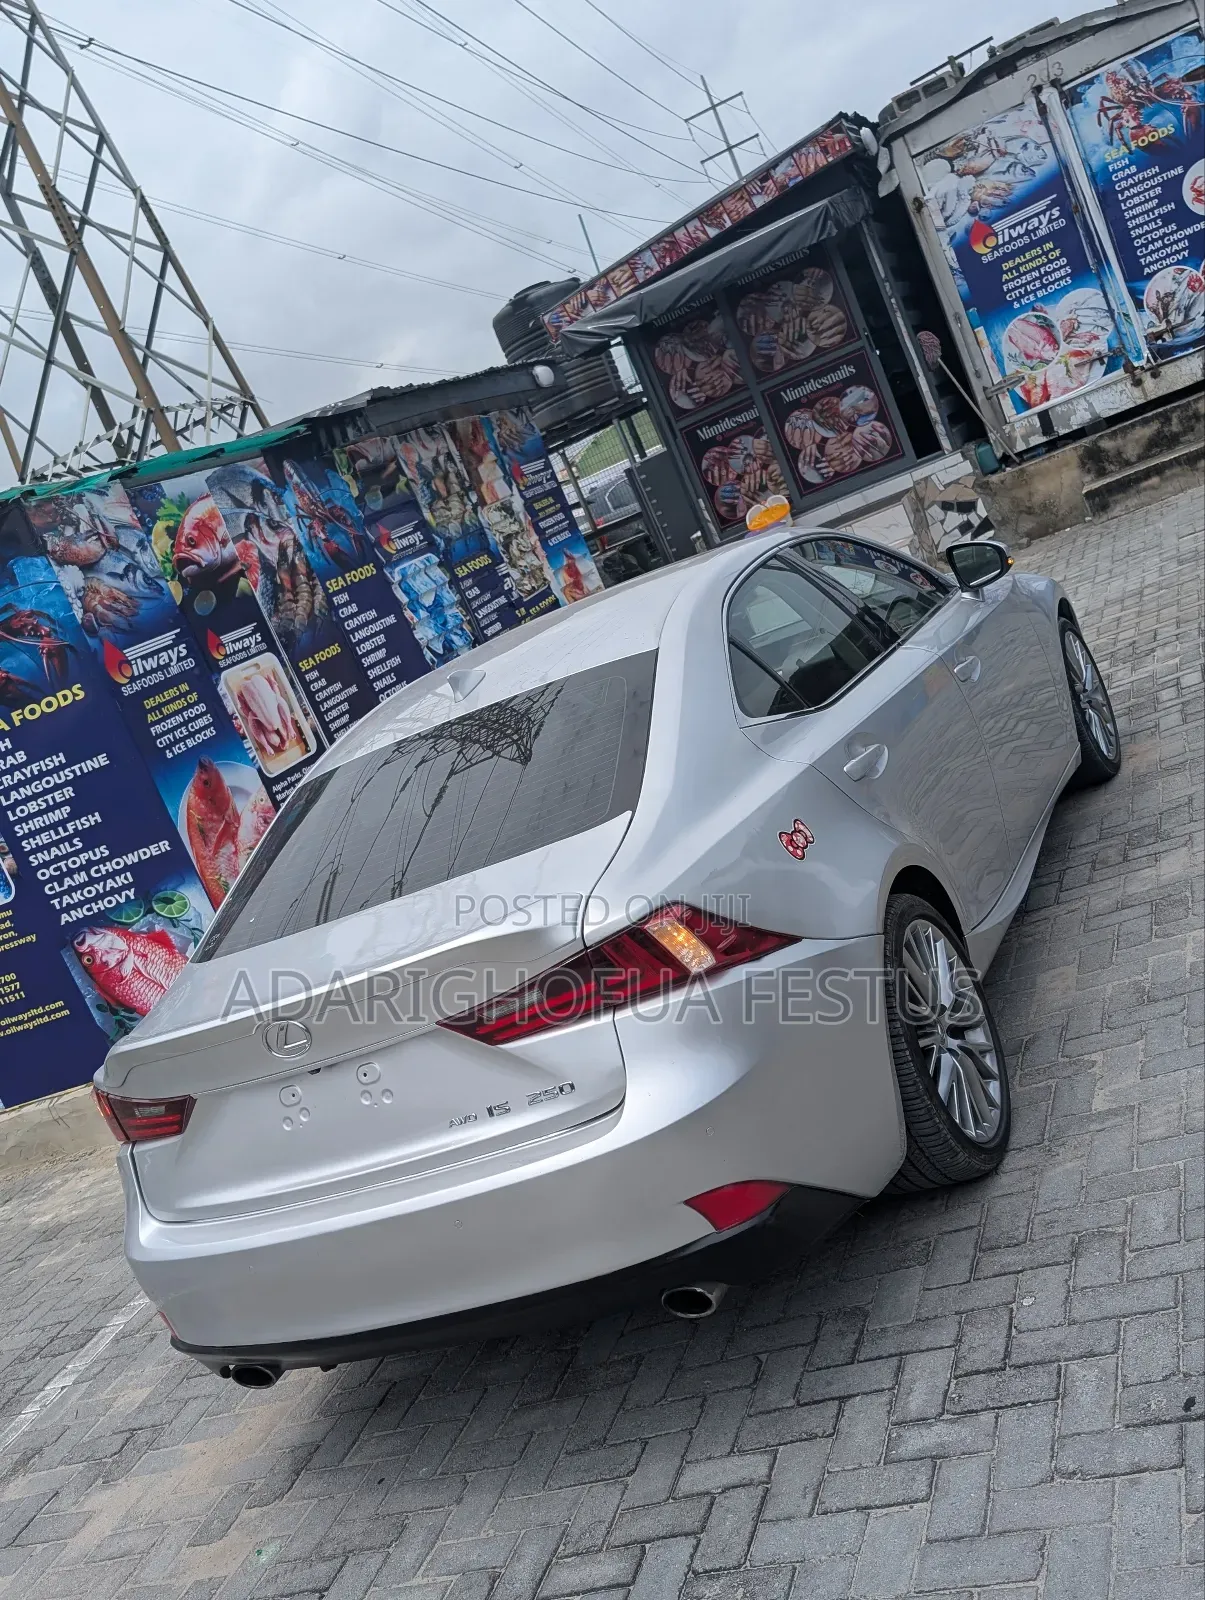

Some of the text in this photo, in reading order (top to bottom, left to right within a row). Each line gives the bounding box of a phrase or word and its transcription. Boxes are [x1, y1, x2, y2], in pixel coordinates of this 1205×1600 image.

[1104, 124, 1176, 162] SEA FOODS
[1108, 158, 1130, 172] FISH
[1112, 165, 1138, 182] CRAB
[1114, 166, 1160, 191] CRAYFISH
[1118, 166, 1184, 200] LANGOUSTINE
[1121, 186, 1162, 210] LOBSTER
[1124, 199, 1159, 220] SHRIMP
[983, 206, 1060, 249] Oilways
[1127, 202, 1176, 228] SHELLFISH
[1130, 219, 1162, 238] SNAILS
[982, 218, 1066, 264] SEAFOODS LIMITED
[1134, 222, 1177, 247] OCTOPUS
[1136, 220, 1205, 256] CLAM CHOWDE
[1002, 242, 1054, 270] DEALERS IN
[1002, 248, 1062, 282] ALL KINDS OF
[1139, 239, 1188, 266] TAKOYAKI
[1144, 250, 1189, 276] ANCHOVY
[1002, 258, 1067, 292] FROZEN FOOD
[1006, 266, 1072, 300] CITY ICE CUBES
[1021, 294, 1036, 304] ICE
[1036, 276, 1072, 298] BLOCKS
[780, 364, 856, 404] Mimidesnails
[697, 405, 760, 442] Mimidesnai
[326, 563, 376, 593] SEA FOODS
[333, 592, 349, 606] FISH
[466, 587, 480, 599] CRAB
[339, 603, 358, 618] CRAB
[344, 609, 377, 630] CRAYFISH
[475, 596, 508, 619] LANGOUSTINE
[350, 614, 397, 642] LANGOUSTINE
[299, 643, 342, 672] SEA FOODS
[356, 634, 386, 655] LOBSTER
[362, 648, 386, 667] SHRIMP
[118, 643, 187, 679] Oilways
[218, 651, 247, 668] SEAFOODS
[367, 656, 401, 680] SHELLFISH
[122, 658, 196, 696] SEAFOODS LIMITED
[305, 670, 319, 682] FISH
[310, 678, 327, 692] CRAB
[373, 672, 396, 692] SNAILS
[10, 684, 85, 726] FOODS
[144, 682, 190, 710] DEALERS IN
[315, 682, 342, 702] CRAYFISH
[320, 684, 358, 712] LANGOUSTINE
[147, 692, 198, 723] ALL KINDS OF
[150, 702, 206, 736] FROZEN FOOD
[324, 702, 350, 722] LOBSTER
[156, 714, 213, 748] CITY ICE CUBES
[329, 714, 350, 732] SHRIMP
[166, 726, 216, 758] & ICE BLOCKS
[0, 753, 110, 806] LANGOUSTINE
[272, 780, 288, 794] Alpha
[7, 786, 76, 822] LOBSTER
[14, 806, 71, 836] SHRIMP
[22, 812, 102, 852] SHELLFISH
[28, 838, 83, 866] SNAILS
[36, 845, 110, 880] OCTOPUS
[44, 840, 171, 895] CLAM CHOWDER
[50, 872, 134, 910] TAKOYAKI
[60, 888, 136, 925] ANCHOVY
[0, 934, 36, 952] ressway
[0, 1000, 64, 1026] oilwaysltd.com
[449, 1080, 577, 1128] AWD IS 250
